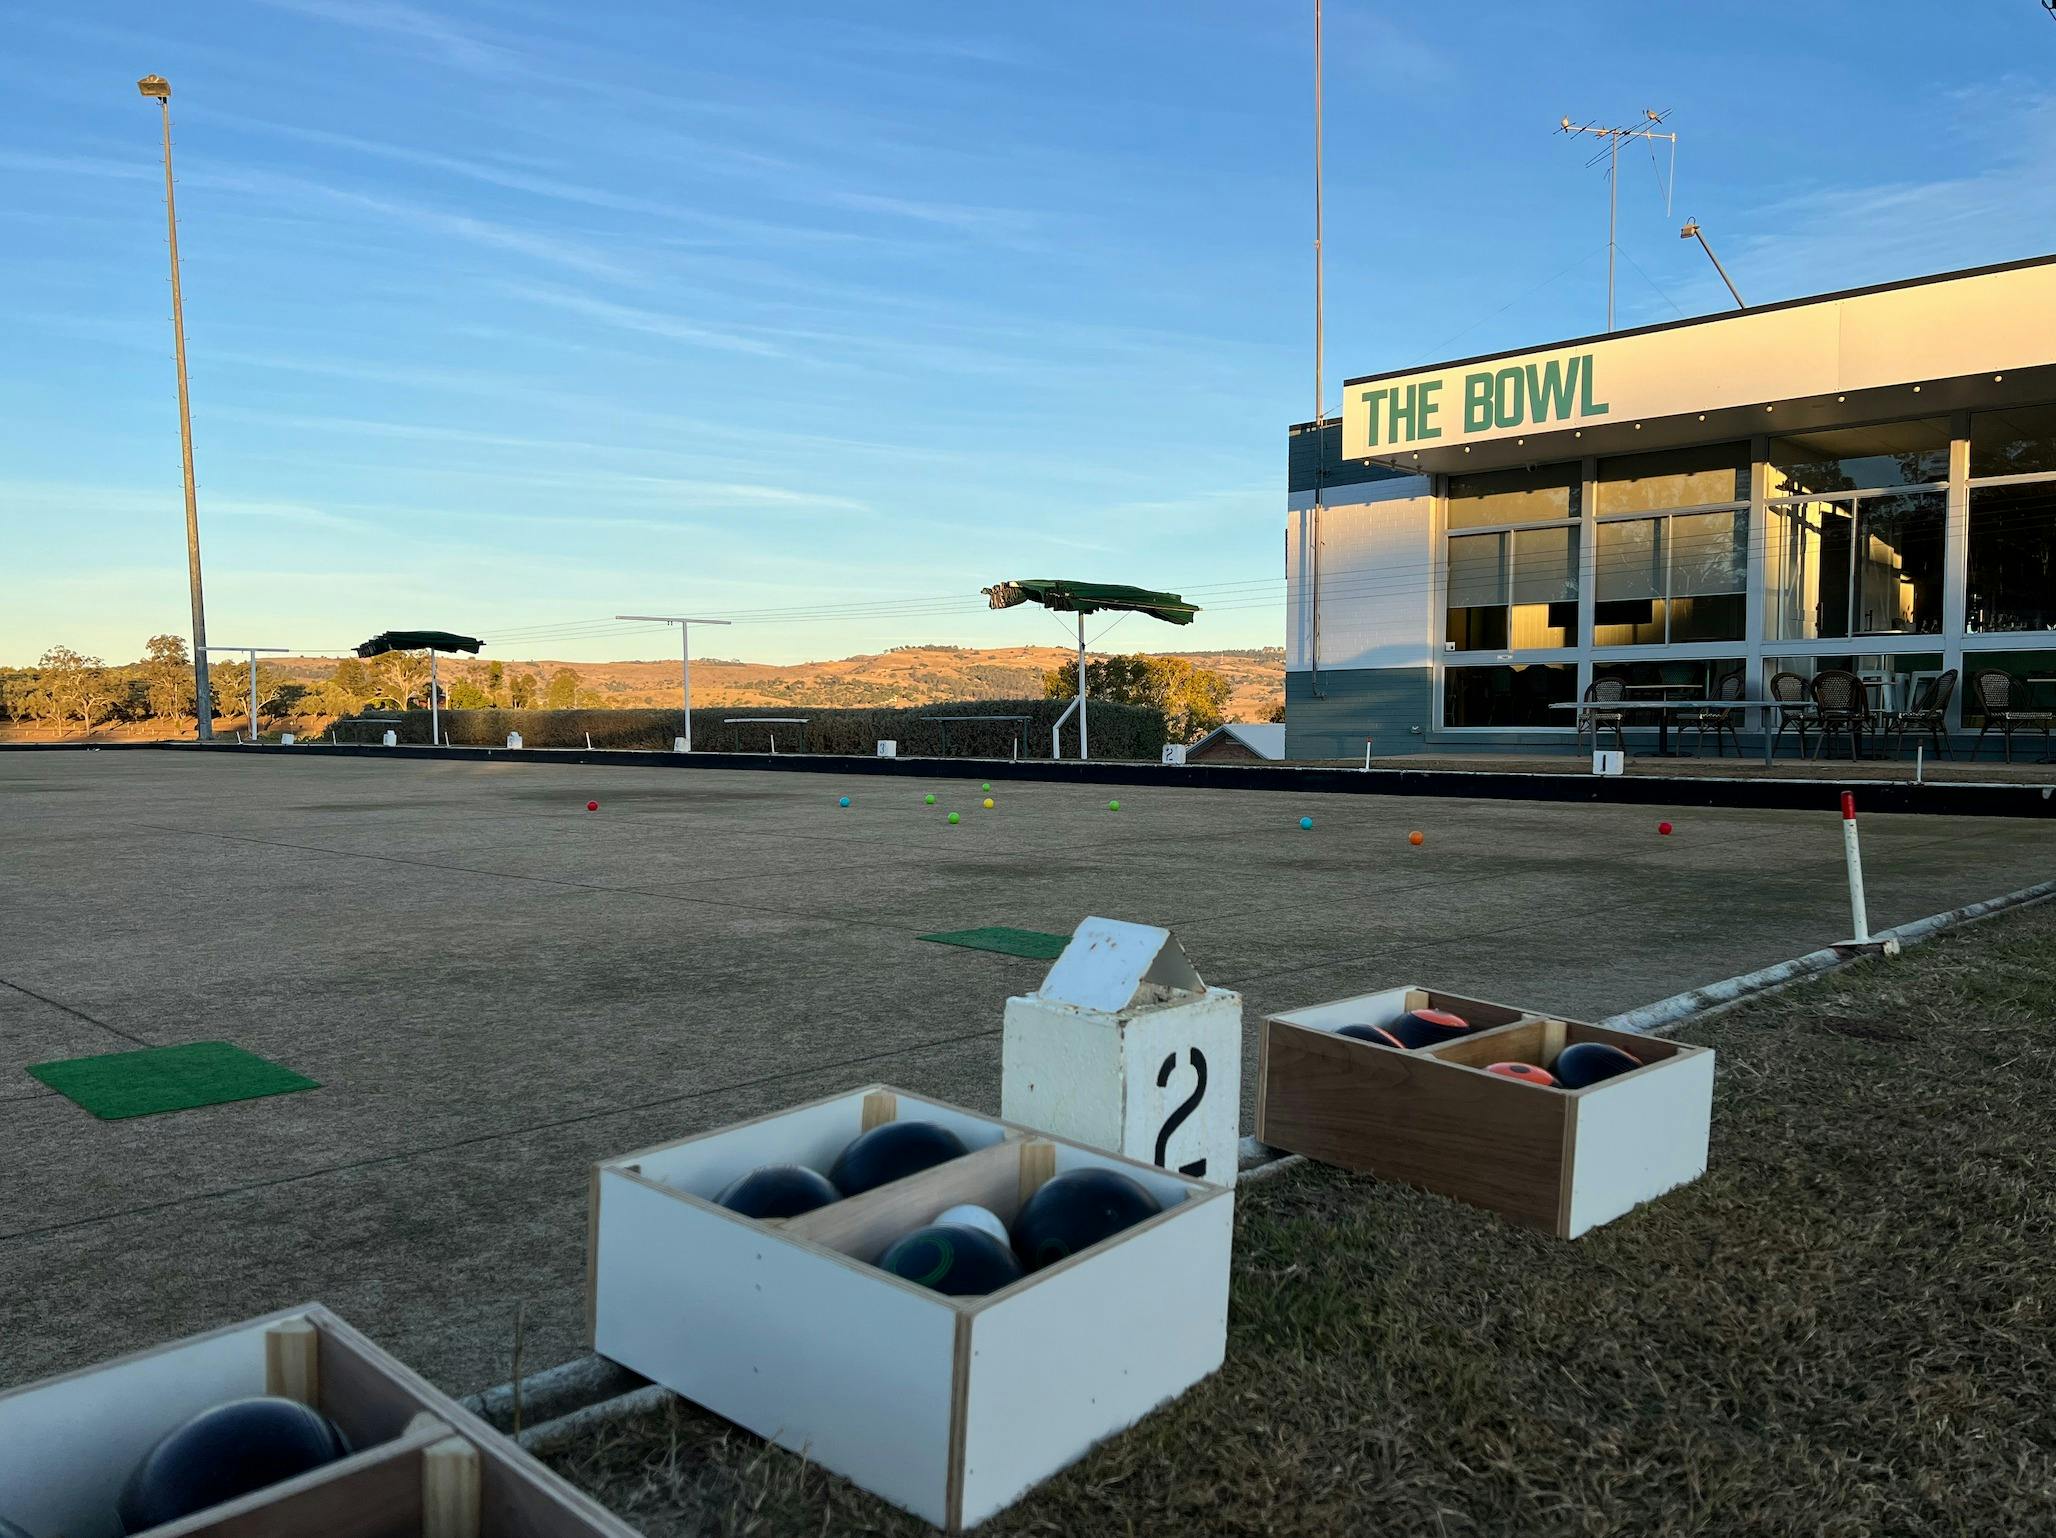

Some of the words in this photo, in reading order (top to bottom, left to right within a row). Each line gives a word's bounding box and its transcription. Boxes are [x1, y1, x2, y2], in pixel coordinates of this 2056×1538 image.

[1362, 380, 1442, 446] THE
[1464, 355, 1609, 433] BOWL
[1165, 748, 1174, 761] 2
[1154, 1046, 1208, 1177] 2
